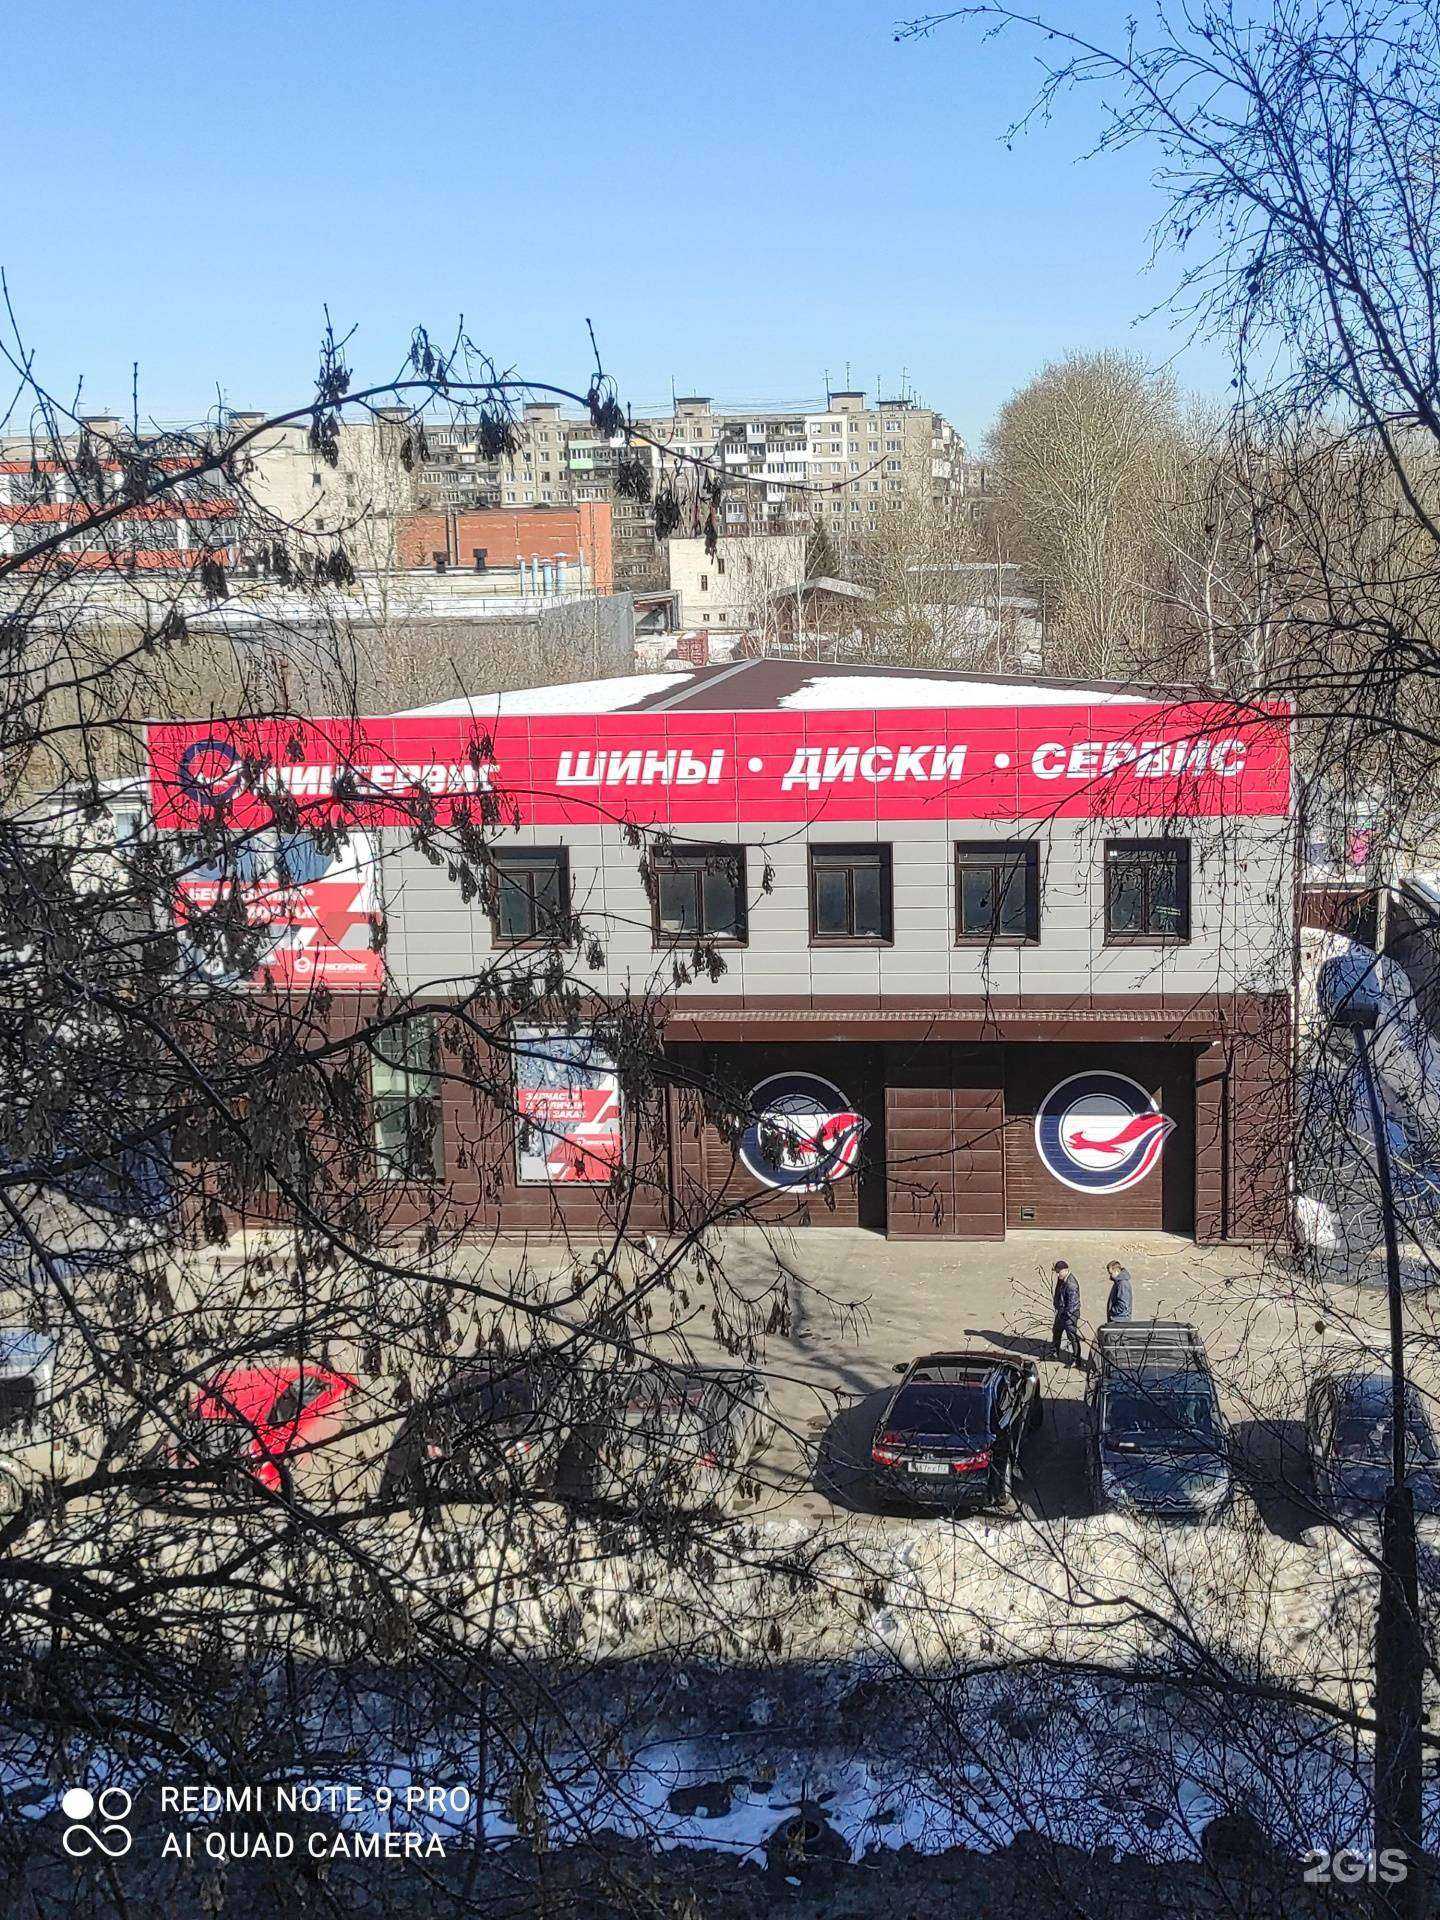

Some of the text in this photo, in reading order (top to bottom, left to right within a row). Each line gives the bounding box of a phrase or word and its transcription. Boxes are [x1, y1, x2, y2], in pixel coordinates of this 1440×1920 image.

[556, 739, 1247, 791] ШИНЫ ДИСКИ СЕРВИС
